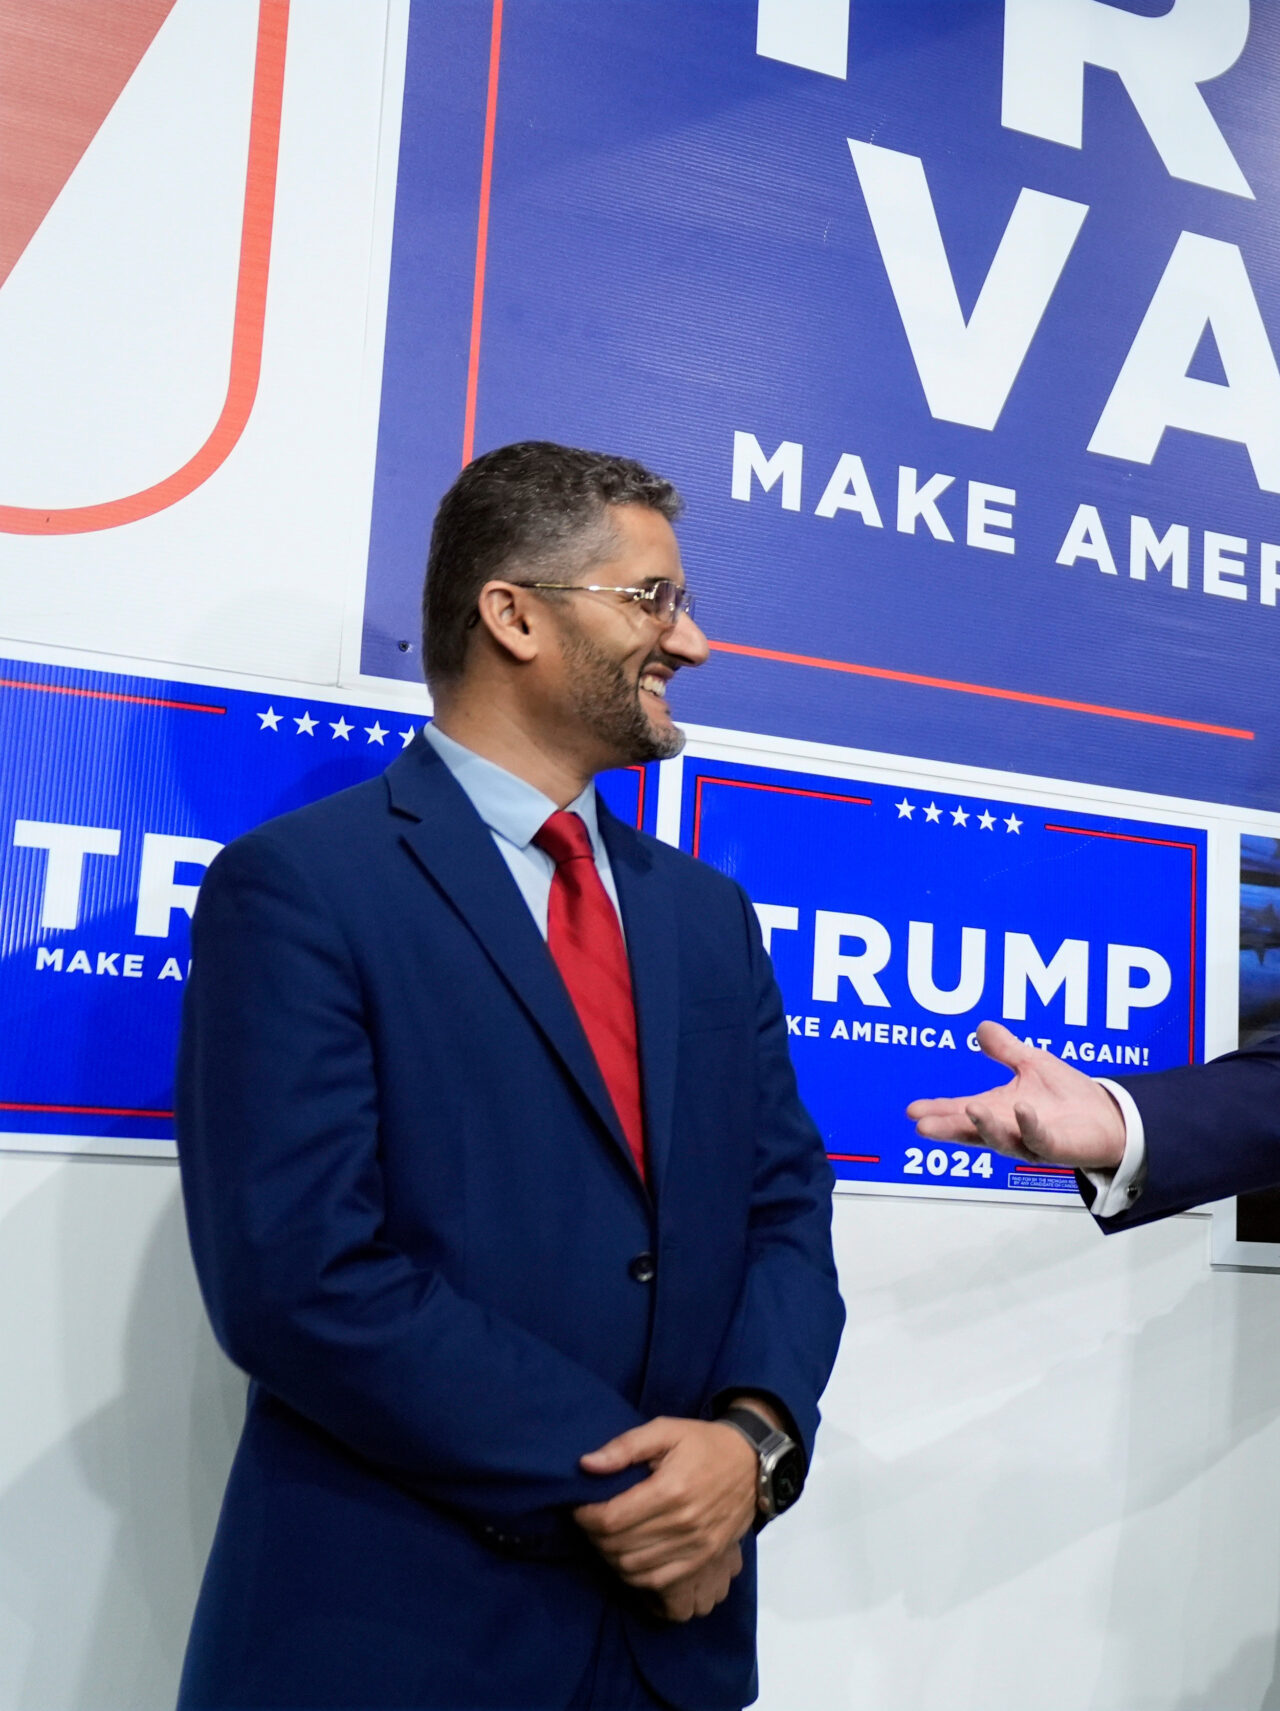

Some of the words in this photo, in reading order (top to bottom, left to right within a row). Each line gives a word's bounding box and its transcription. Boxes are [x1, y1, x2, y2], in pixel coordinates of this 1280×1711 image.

[731, 431, 1016, 555] MAKE
[36, 947, 144, 978] MAKE
[785, 1015, 820, 1037] KE
[831, 1020, 956, 1050] AMERICA
[1060, 1040, 1149, 1066] AGAIN!
[903, 1147, 993, 1178] 2024
